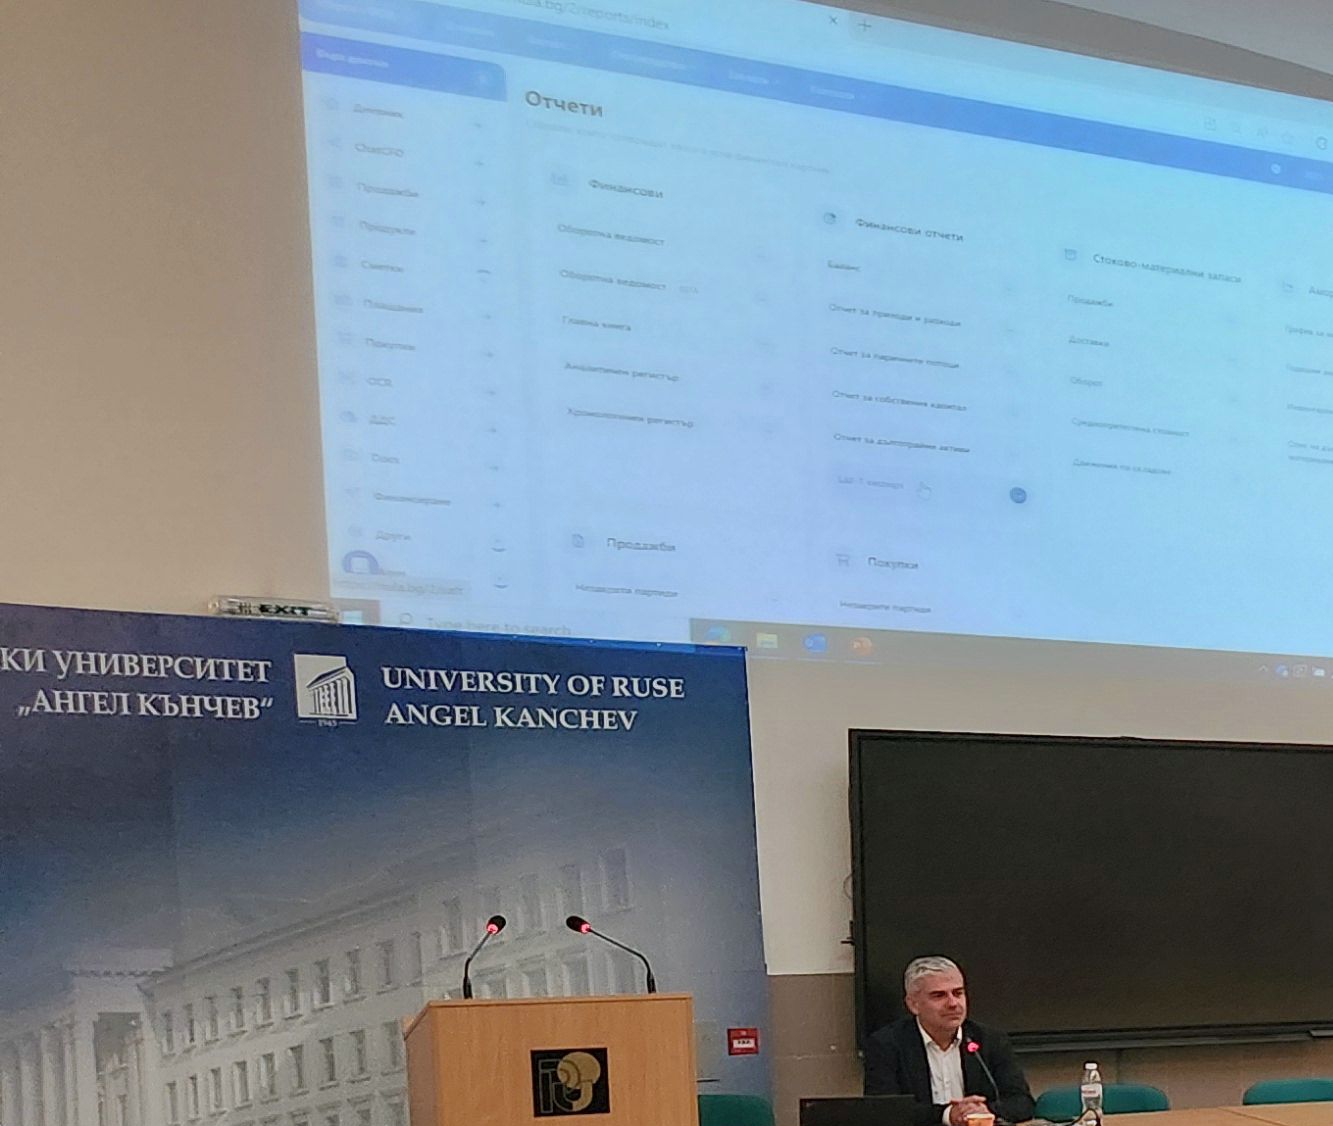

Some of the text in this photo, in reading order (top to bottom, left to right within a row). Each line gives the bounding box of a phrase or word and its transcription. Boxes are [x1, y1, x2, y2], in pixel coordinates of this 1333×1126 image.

[525, 91, 604, 118] Отчети
[588, 179, 664, 200] Финансови
[855, 219, 965, 242] Финансови отчети
[258, 603, 313, 617] EXIT
[54, 649, 273, 687] УНИВЕРСИТЕТ
[380, 665, 686, 701] UNIVERSITY OF RUSE
[385, 702, 640, 733] ANGEL KANCHEV
